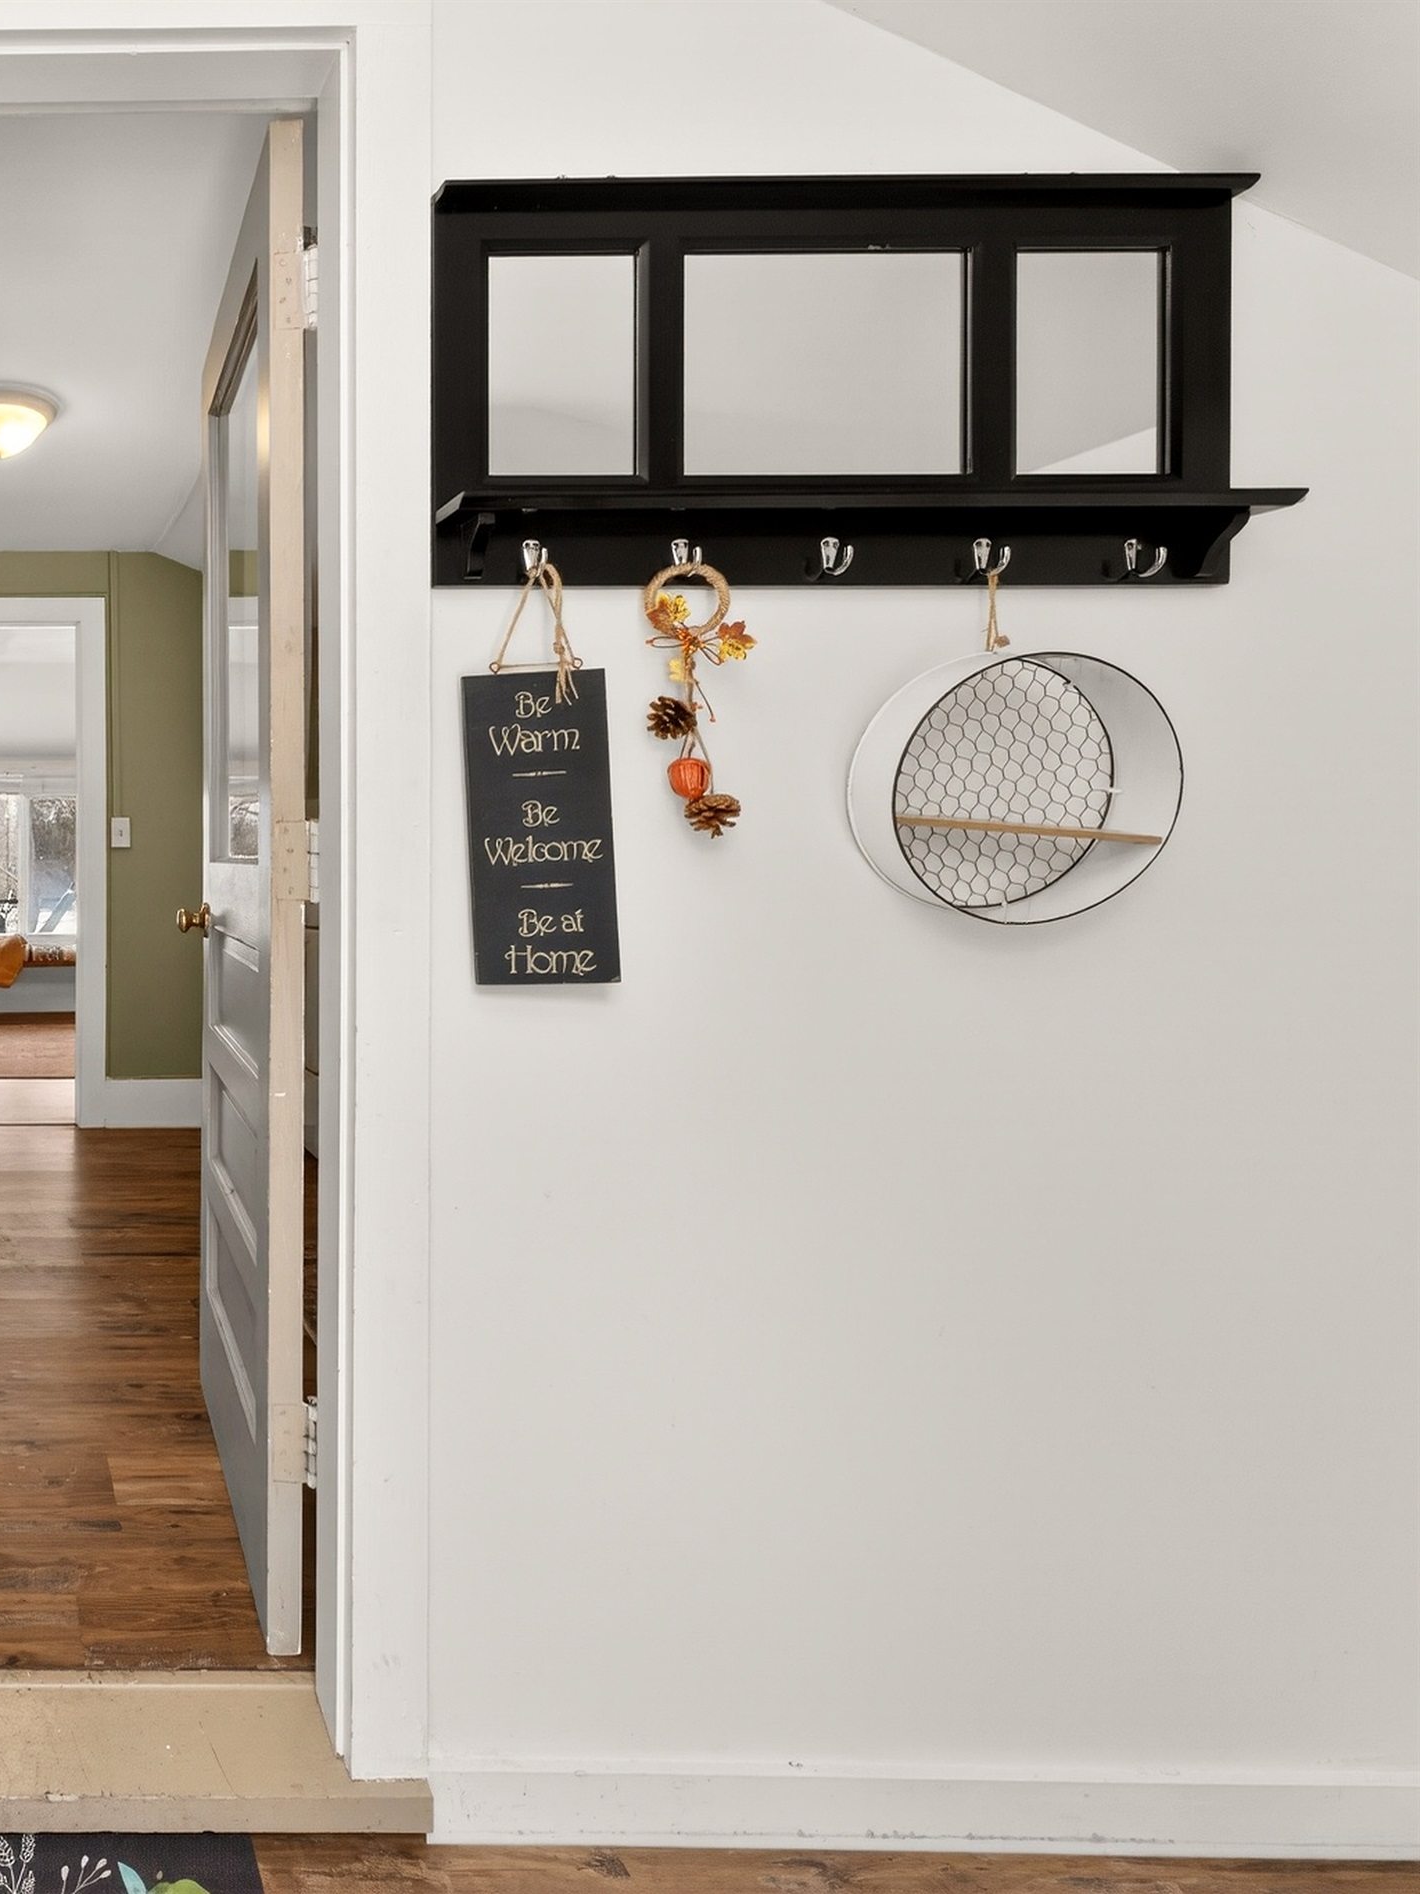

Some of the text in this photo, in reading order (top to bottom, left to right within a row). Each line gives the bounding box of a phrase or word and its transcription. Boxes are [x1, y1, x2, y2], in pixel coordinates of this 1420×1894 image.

[514, 691, 553, 719] Be
[488, 723, 581, 757] Warm
[521, 800, 561, 828] Be
[484, 835, 604, 867] Welcome
[517, 908, 585, 937] Be at
[504, 945, 598, 976] Home
